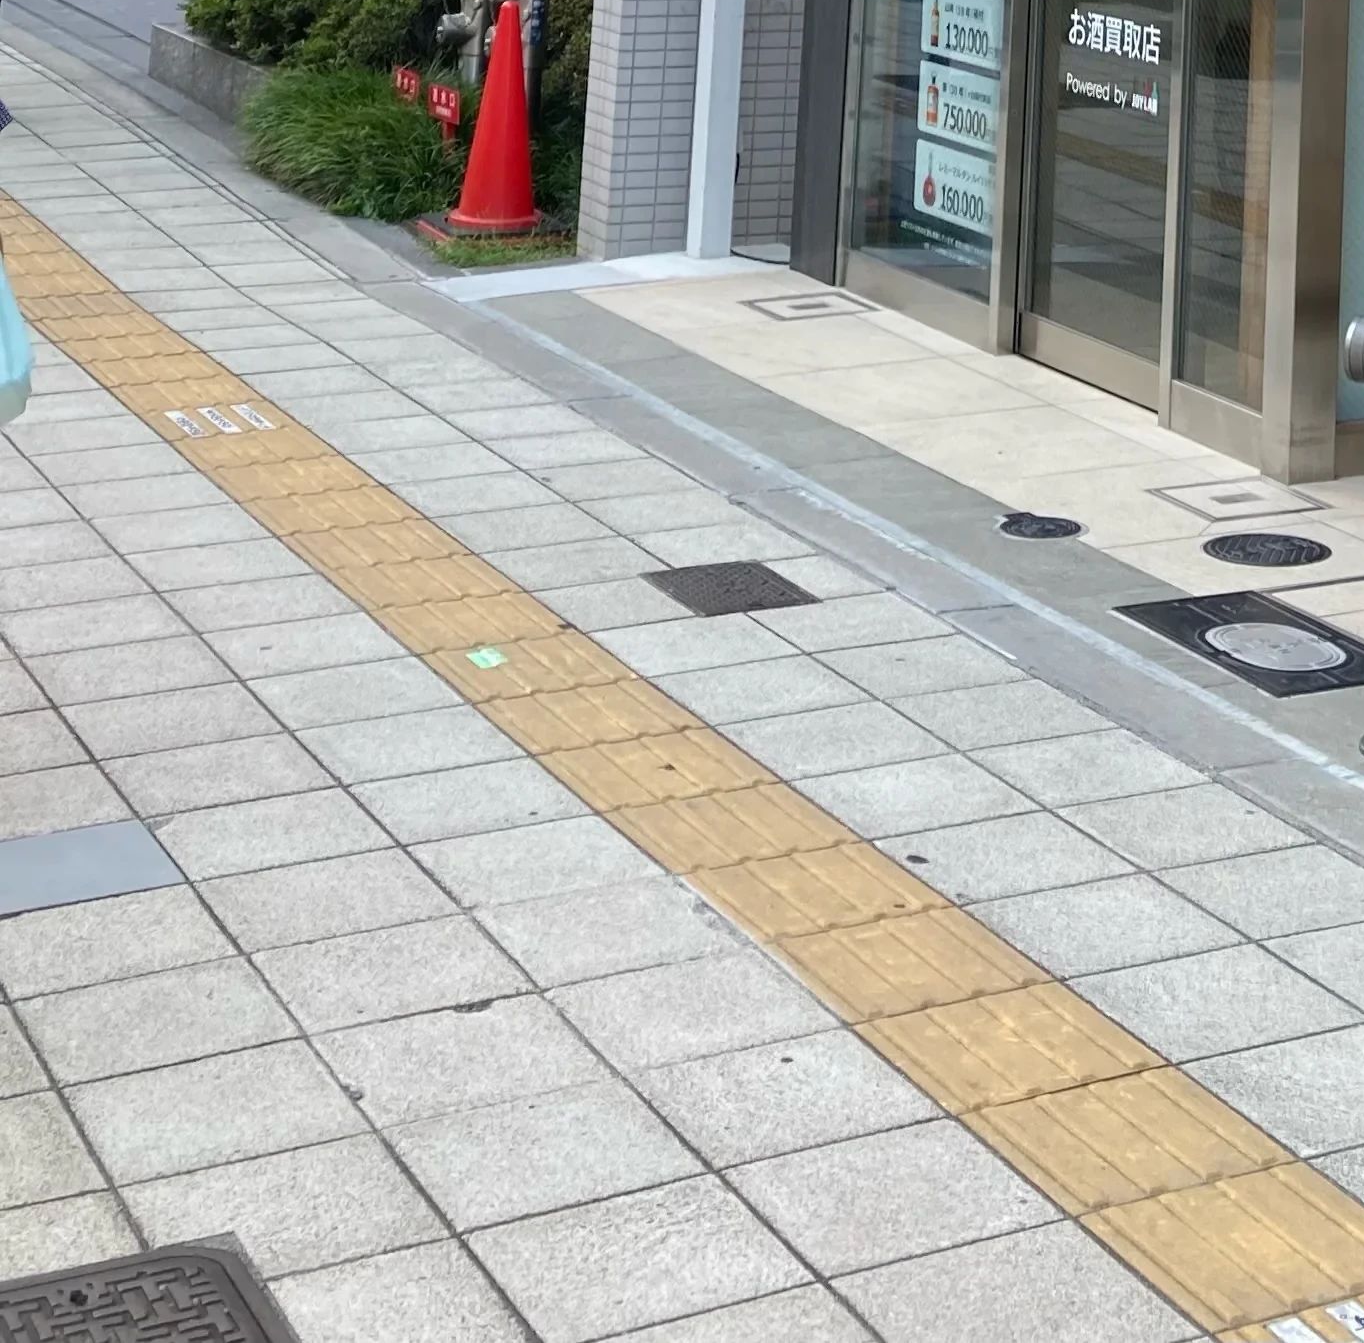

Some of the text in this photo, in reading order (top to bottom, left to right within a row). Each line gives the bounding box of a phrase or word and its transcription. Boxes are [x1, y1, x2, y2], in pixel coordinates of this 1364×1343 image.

[1068, 8, 1161, 65] お酒買取店
[1066, 72, 1110, 101] Powered
[1114, 82, 1128, 110] by
